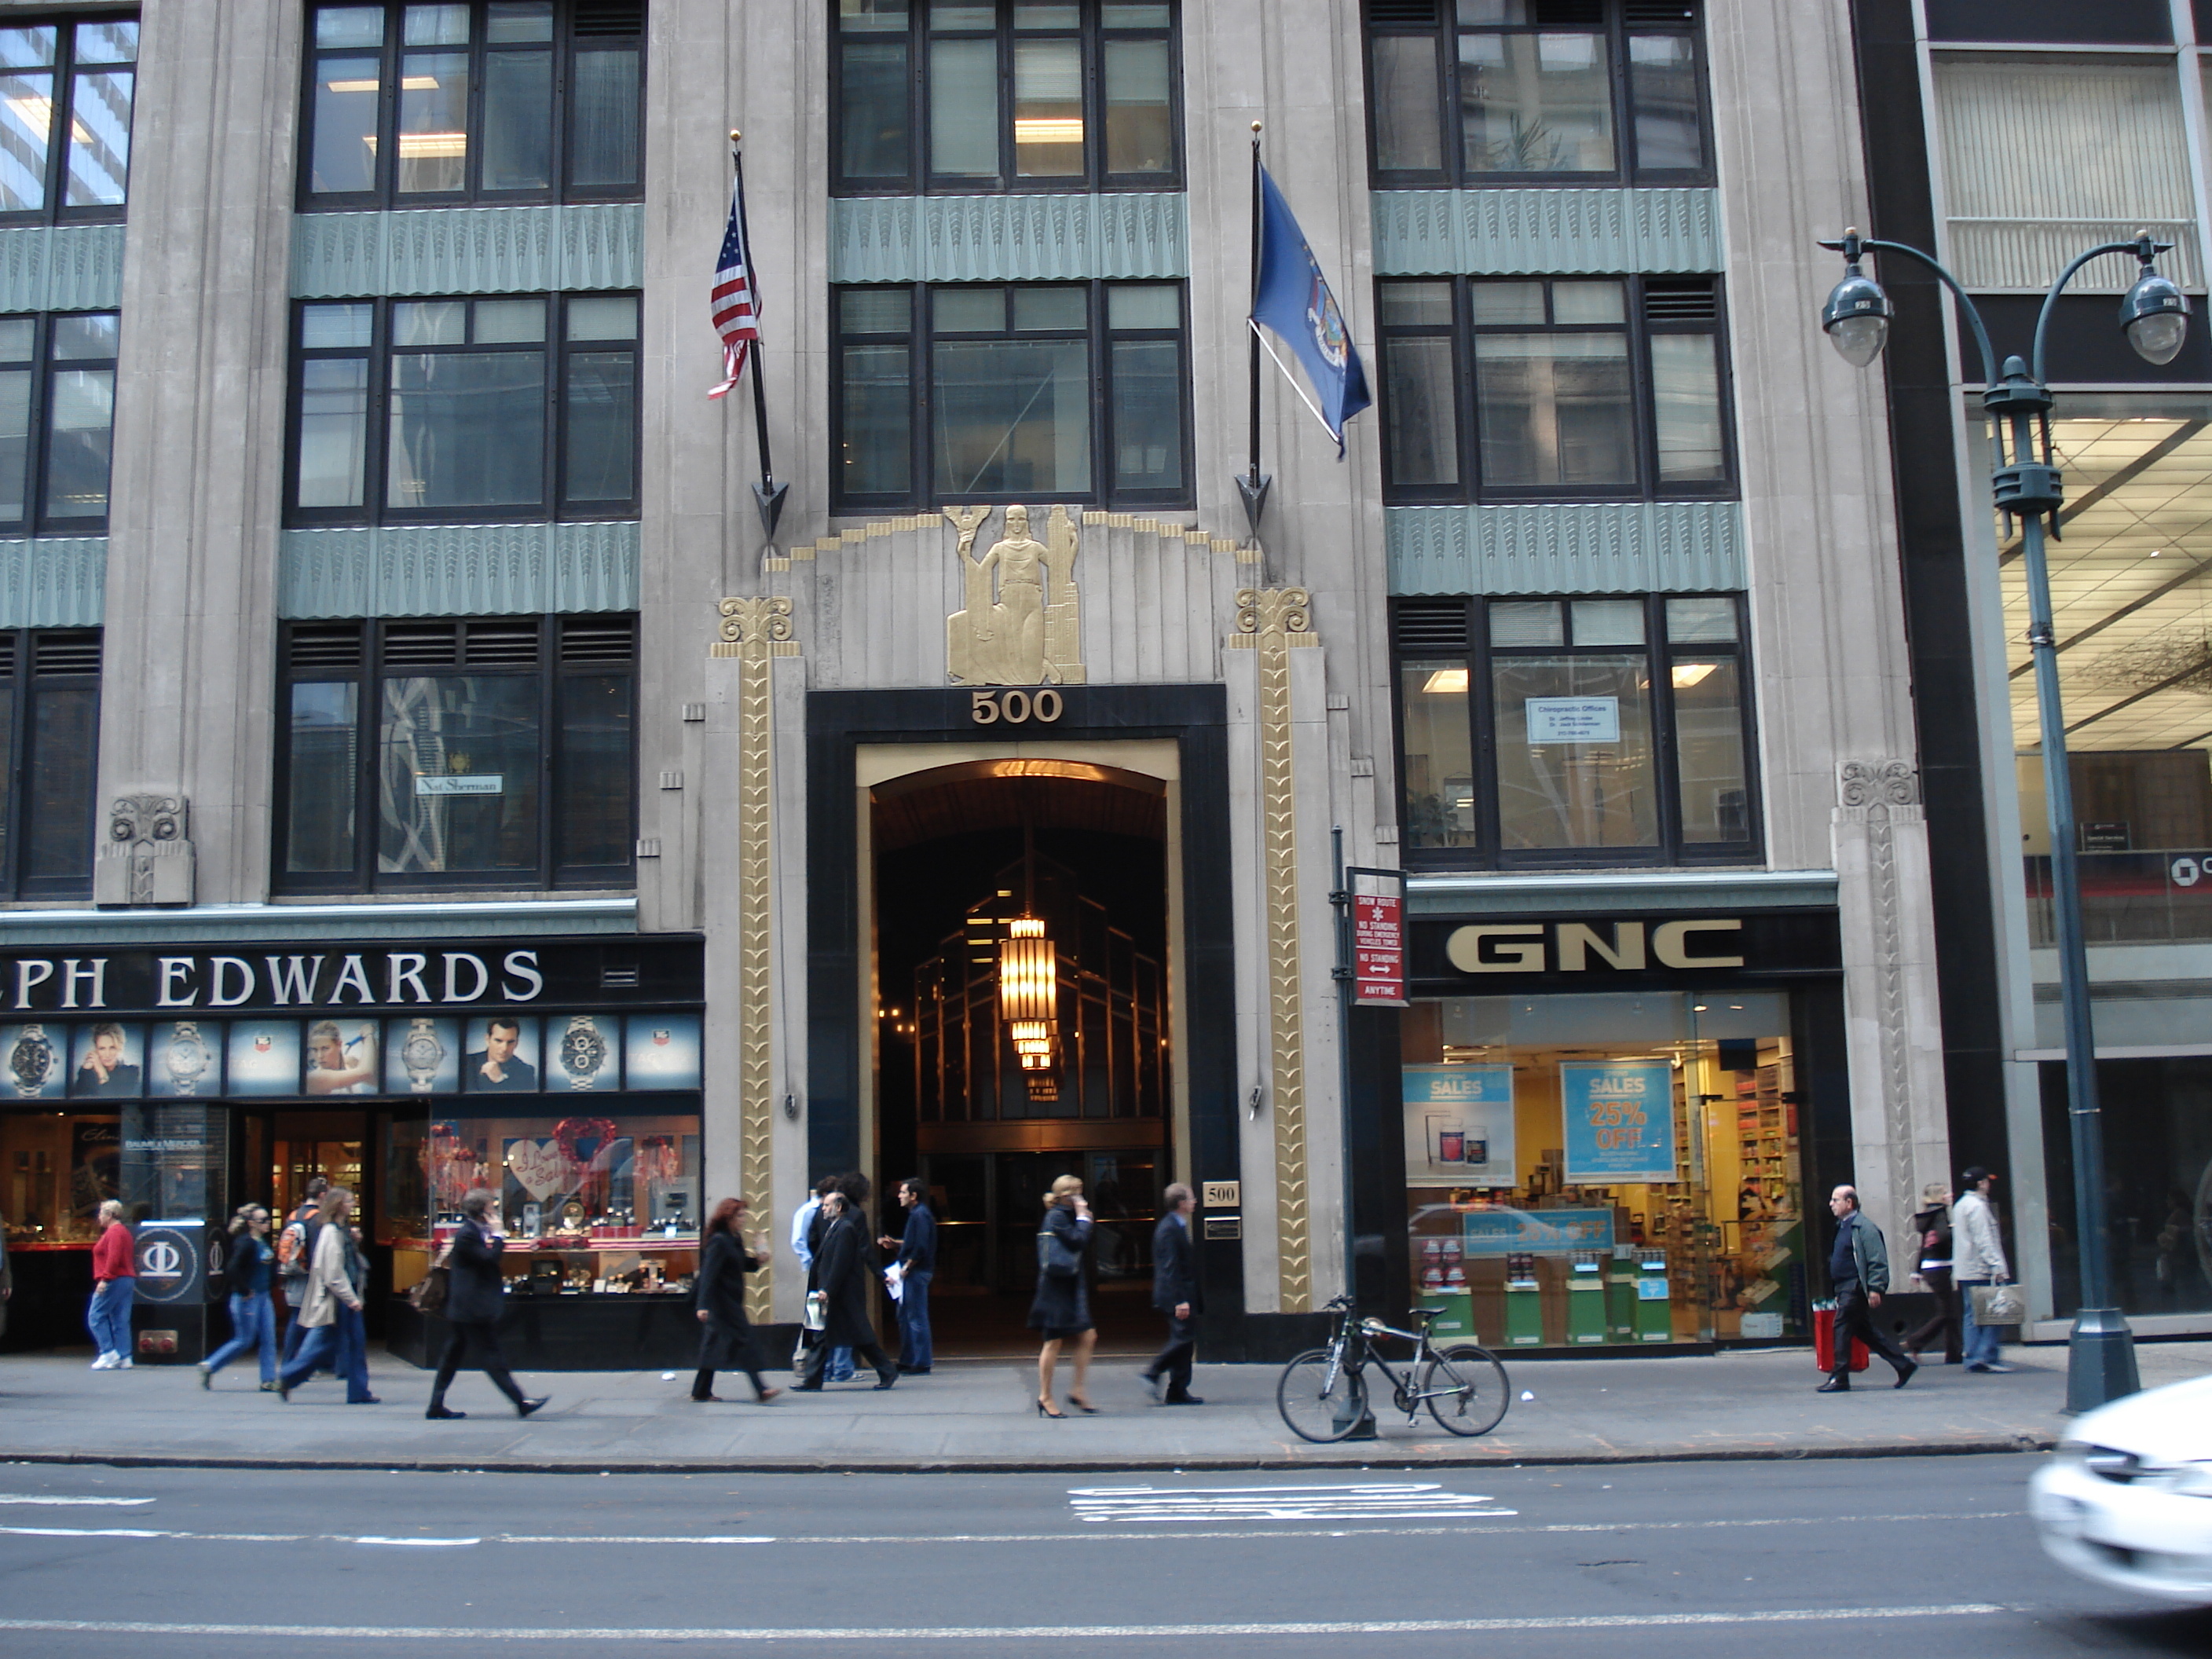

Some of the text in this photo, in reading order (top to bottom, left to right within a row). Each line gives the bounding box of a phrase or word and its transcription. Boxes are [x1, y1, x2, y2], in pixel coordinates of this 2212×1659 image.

[972, 689, 1064, 724] 500
[420, 778, 496, 793] Nat Sherman
[1358, 896, 1397, 907] SNOW ROUTE
[1358, 921, 1397, 932] NO STANDING
[1446, 919, 1745, 973] GNC
[1359, 953, 1399, 964] NO STANDING
[0, 950, 544, 1009] PH EDWARDS
[1364, 985, 1397, 996] ANYTIME
[1430, 1080, 1483, 1096] SALES
[1589, 1077, 1646, 1094] SALES
[1590, 1101, 1647, 1126] 25%
[1596, 1128, 1643, 1149] OFF
[1208, 1187, 1235, 1202] 500
[1566, 1220, 1607, 1240] OFF
